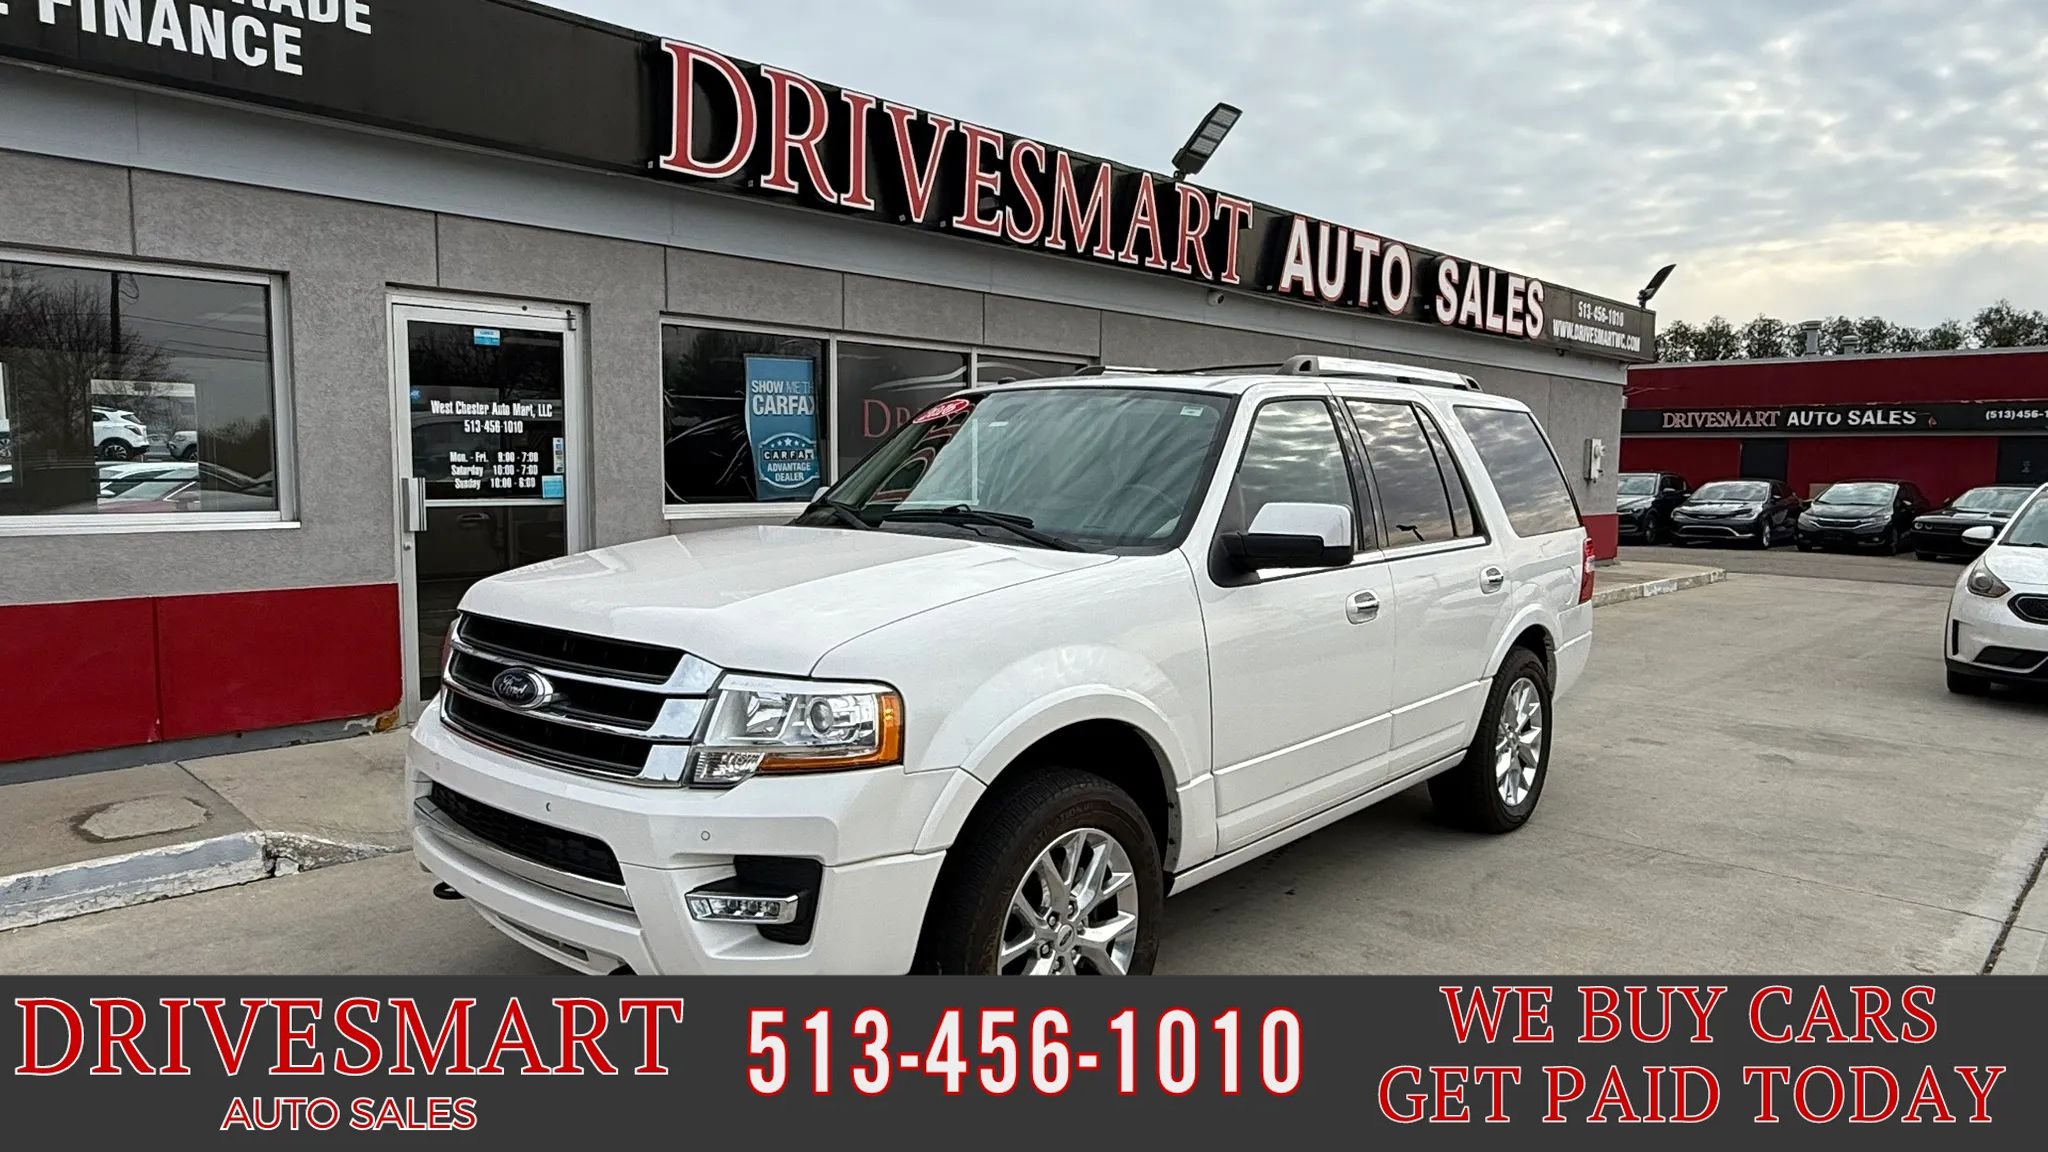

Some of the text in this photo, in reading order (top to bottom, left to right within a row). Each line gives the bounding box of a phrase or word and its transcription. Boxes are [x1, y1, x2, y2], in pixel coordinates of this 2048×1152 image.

[660, 38, 1545, 340] DRIVESMART AUTO SALES
[751, 380, 784, 394] SHOW
[430, 400, 453, 414] West
[455, 401, 489, 415] Chester
[491, 402, 511, 416] Auto
[538, 404, 553, 417] LLC
[1662, 410, 1917, 428] DRIVESMART AUTO SALES
[464, 420, 523, 433] 513-456-1010
[451, 464, 483, 477] Saturday
[767, 462, 811, 472] ADVANTAGE
[775, 472, 804, 481] DEALER
[455, 477, 481, 490] Sunday
